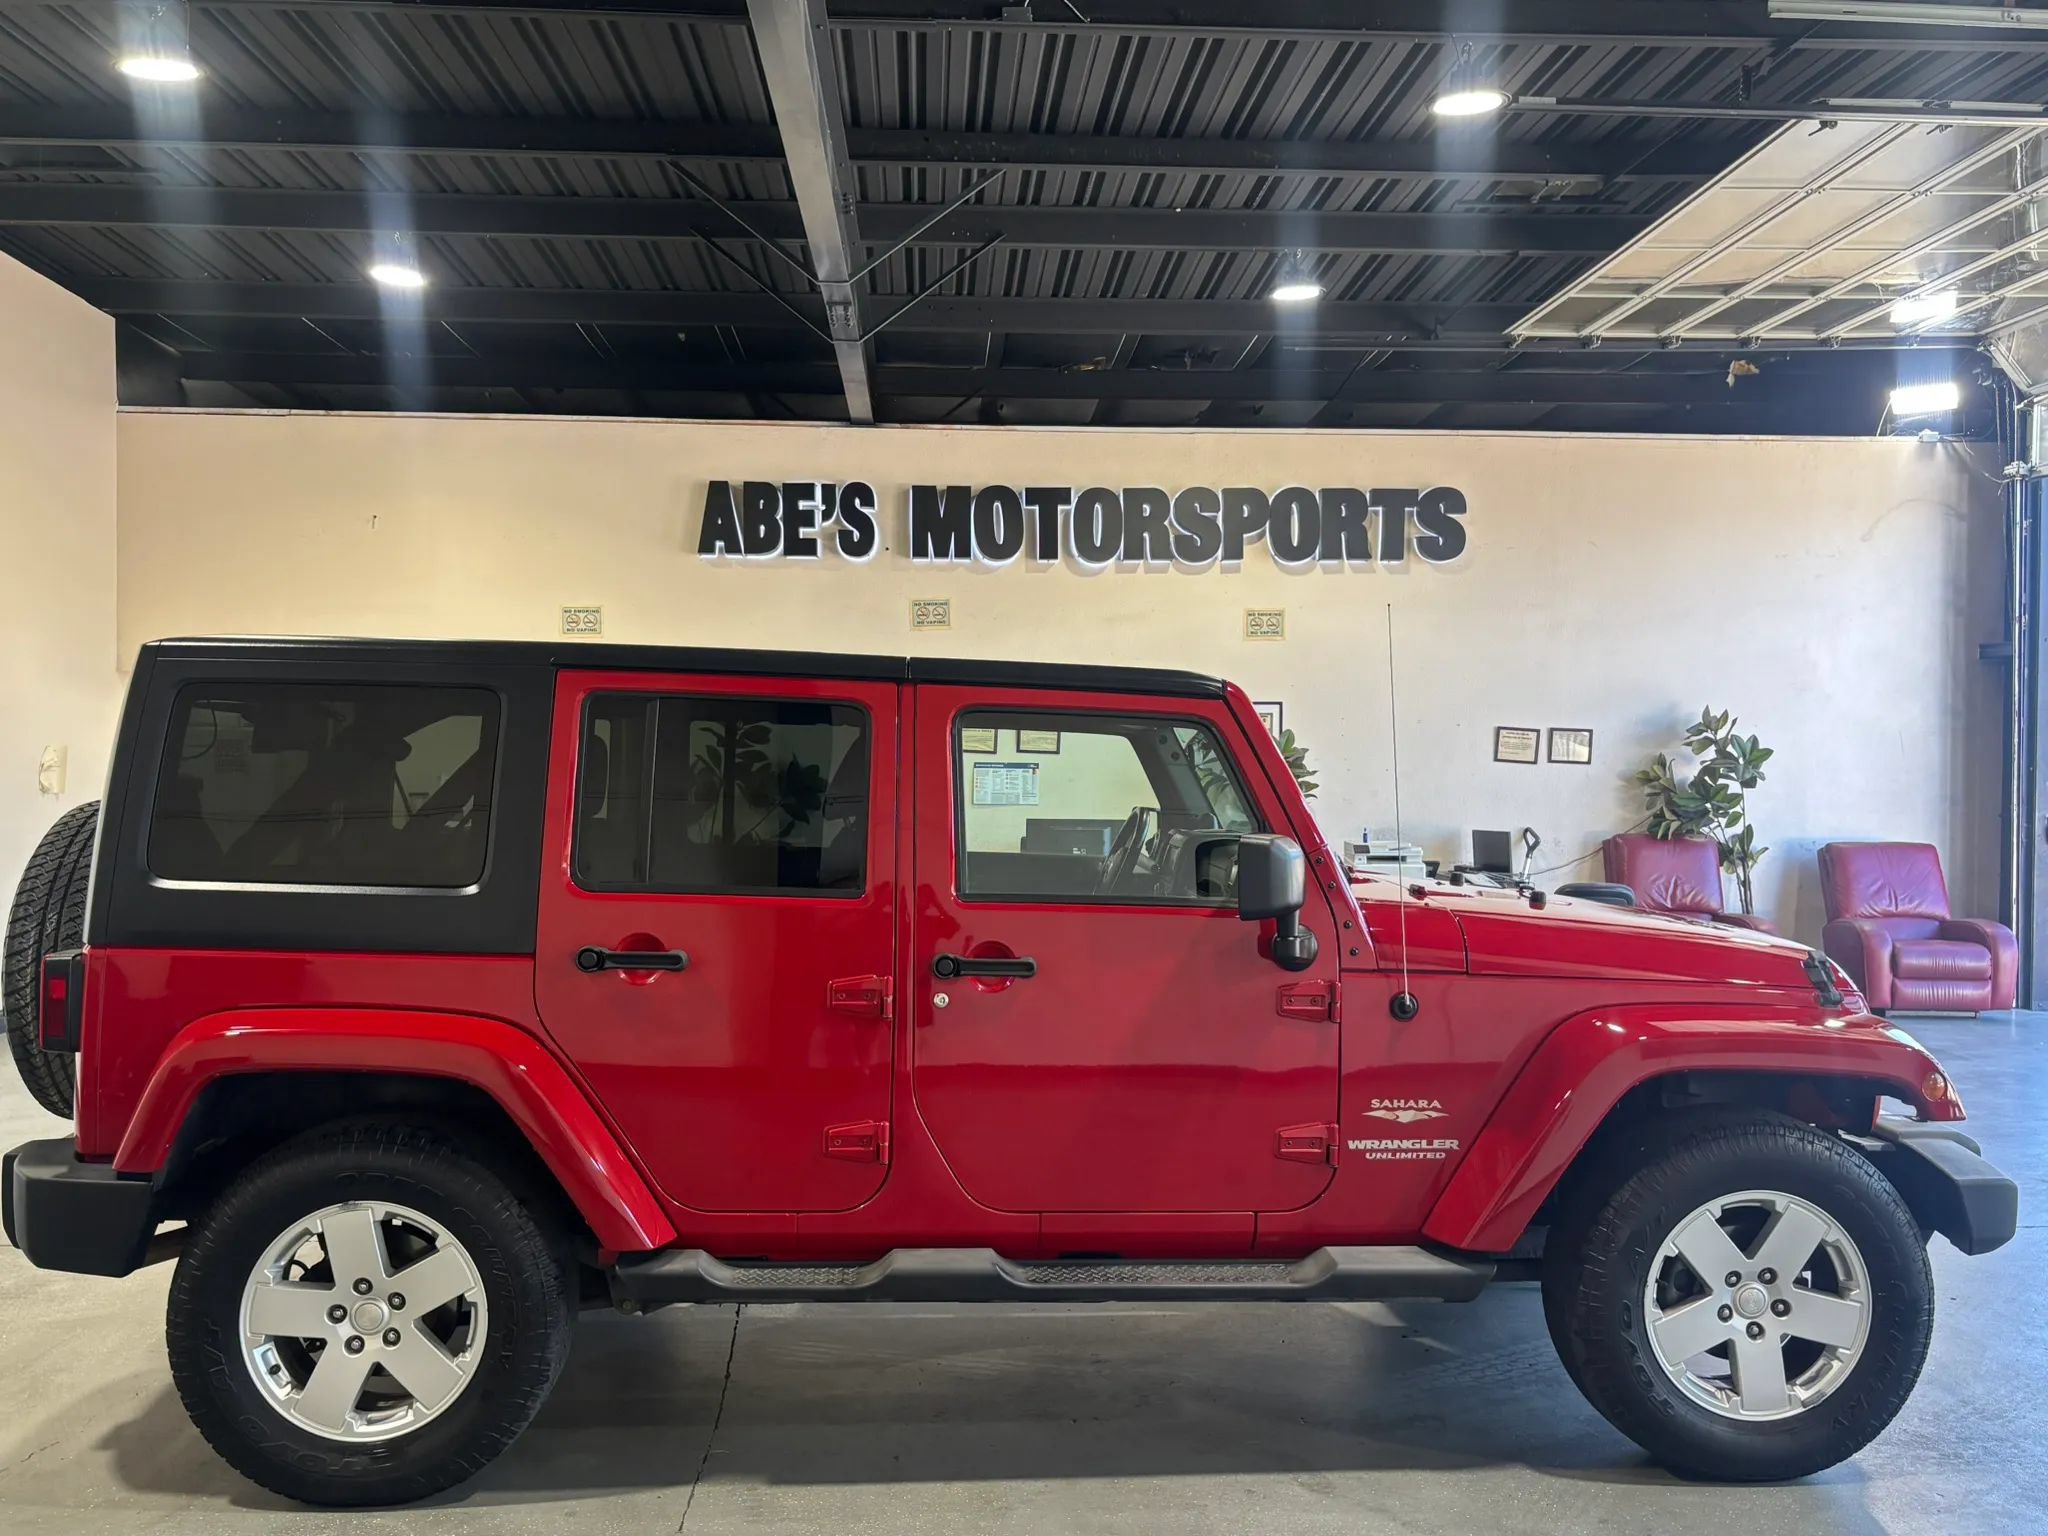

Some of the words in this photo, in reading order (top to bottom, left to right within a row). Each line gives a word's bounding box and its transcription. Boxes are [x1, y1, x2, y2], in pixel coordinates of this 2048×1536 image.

[697, 480, 876, 559] ABE'S
[910, 484, 1467, 564] MOTORSPORTS
[1370, 1098, 1442, 1109] SAHARA
[1347, 1139, 1460, 1150] WRANGLER
[1365, 1151, 1446, 1160] UNLIMITED
